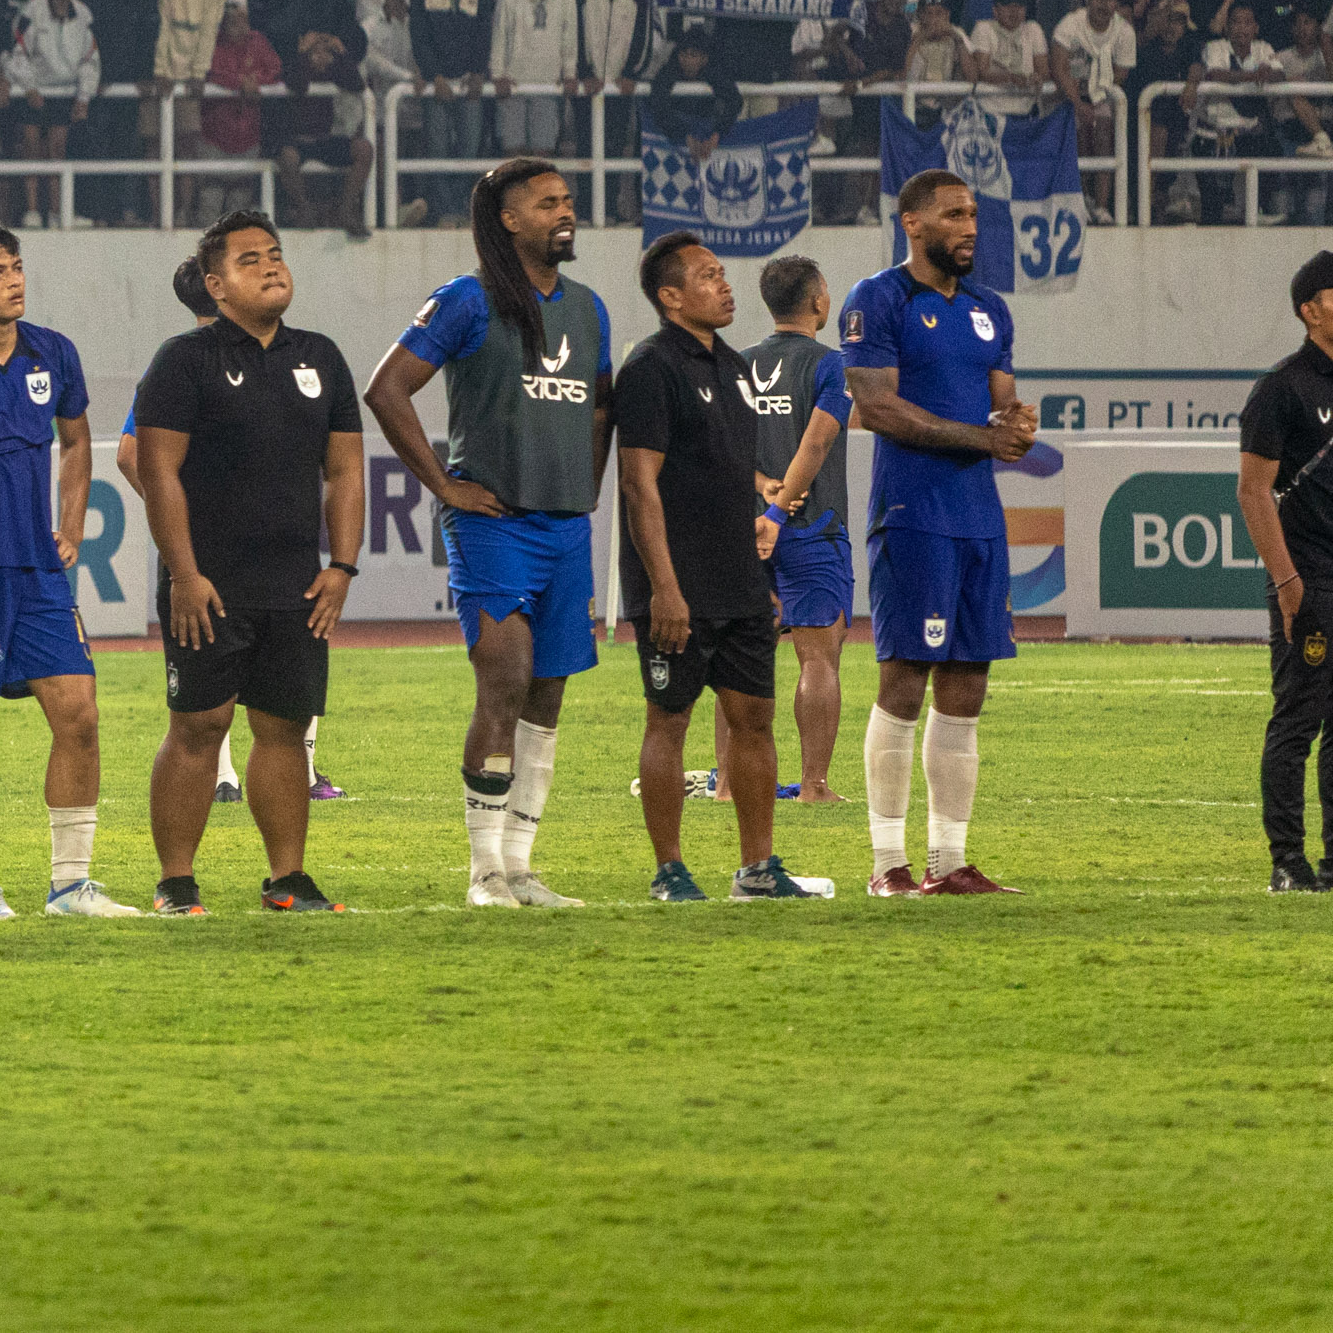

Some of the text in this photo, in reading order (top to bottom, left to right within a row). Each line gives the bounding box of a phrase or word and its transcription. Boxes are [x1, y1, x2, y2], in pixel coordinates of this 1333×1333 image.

[1019, 207, 1084, 281] 32
[1107, 400, 1151, 429] PT
[1132, 511, 1268, 569] BOL
